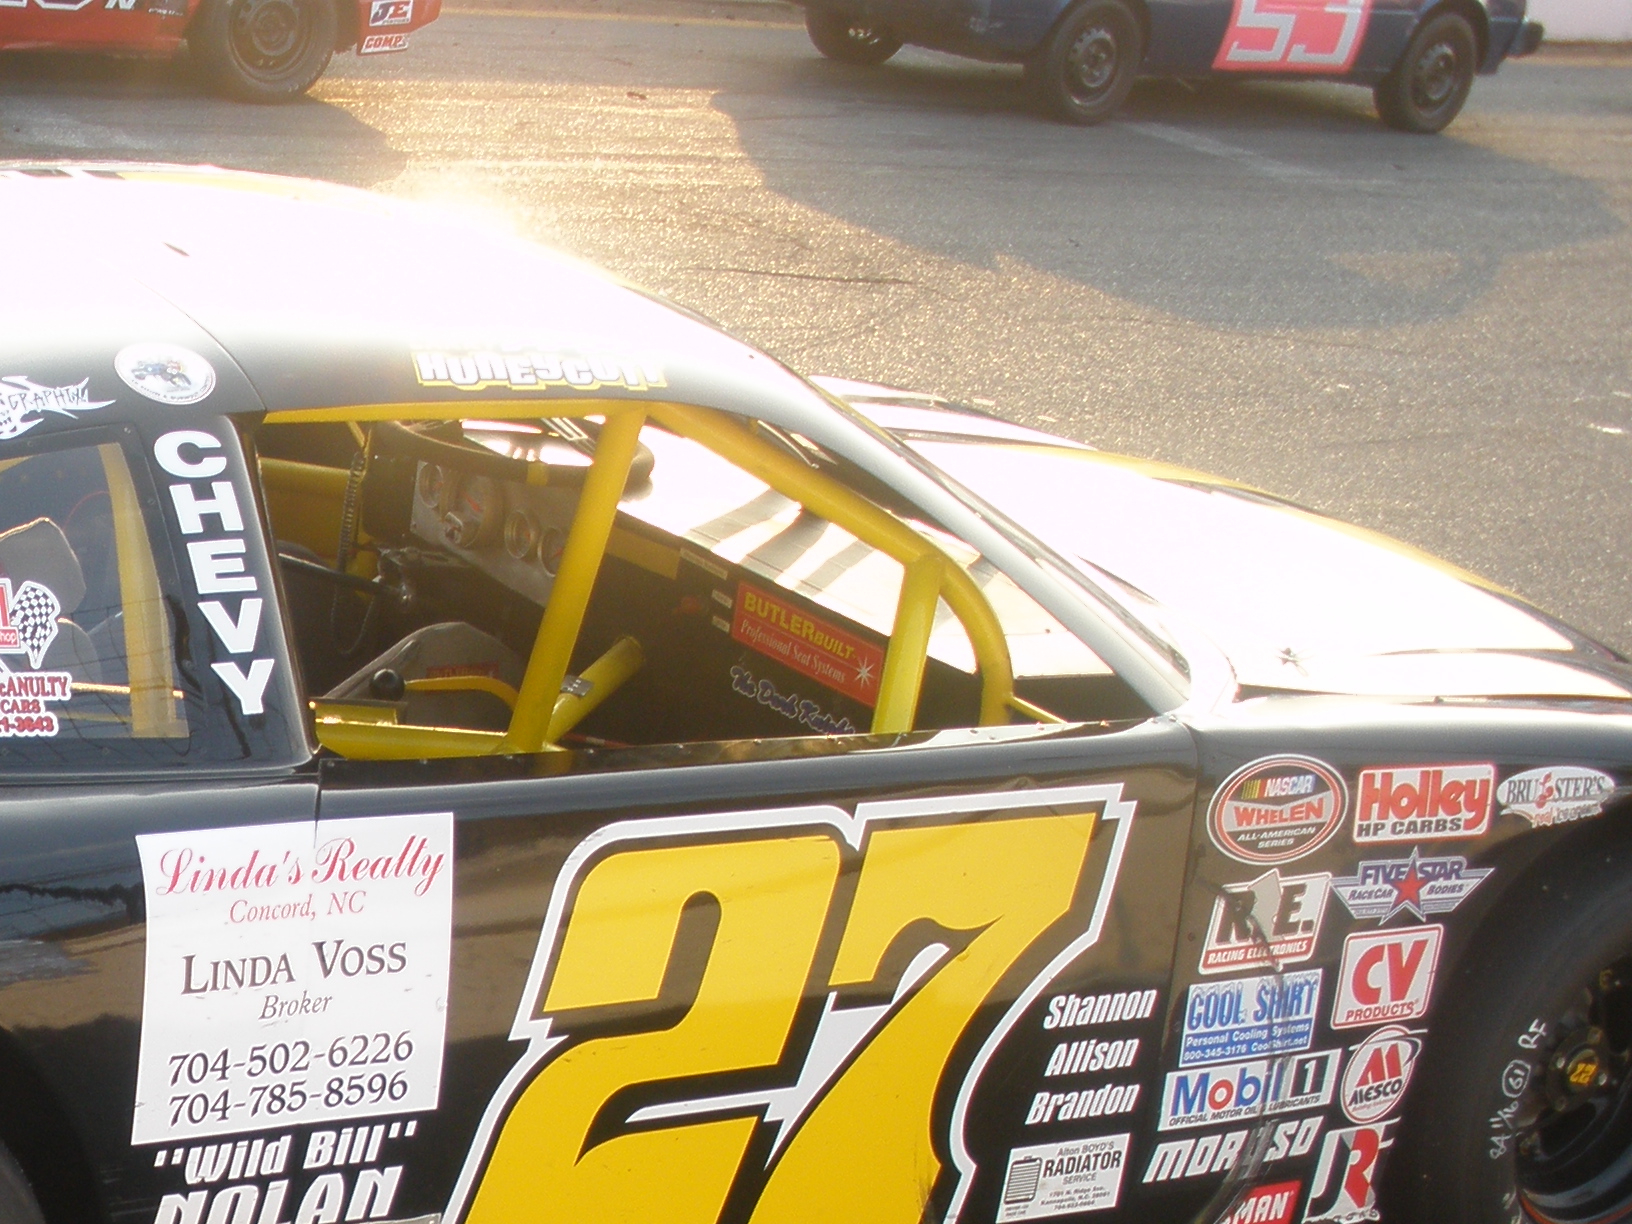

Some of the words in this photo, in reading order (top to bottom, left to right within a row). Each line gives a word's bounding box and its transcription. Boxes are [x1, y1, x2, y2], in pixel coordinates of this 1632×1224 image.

[154, 430, 275, 716] CHEVY
[741, 619, 792, 656] Professional
[812, 655, 846, 684] Systems
[0, 699, 41, 714] CARS
[1264, 775, 1314, 797] NASCAR
[1358, 769, 1491, 831] Holley
[1234, 797, 1324, 827] WHELEN
[1356, 822, 1386, 837] HP
[1390, 817, 1462, 836] CARBS
[1258, 838, 1295, 849] SERIES
[156, 847, 305, 896] Linda's
[311, 835, 445, 897] Realty
[1360, 862, 1410, 886] FIVE
[1417, 860, 1463, 880] STAR
[1427, 883, 1464, 896] BODIES
[229, 894, 317, 923] Concord,
[326, 890, 367, 915] NC
[181, 953, 297, 996] LINDA
[311, 939, 407, 979] VOSS
[1207, 949, 1245, 965] RACING
[1352, 939, 1429, 1006] CV
[258, 991, 333, 1021] Broker
[1043, 989, 1157, 1030] Shannon
[1188, 982, 1246, 1031] COOL
[1345, 1001, 1415, 1022] PRODUCTS
[1186, 1032, 1228, 1048] Personal
[1232, 1028, 1268, 1042] Cooling
[1272, 1022, 1310, 1037] Systems
[168, 1030, 414, 1087] 704-502-6226
[1044, 1038, 1140, 1077] Allison
[168, 1070, 408, 1127] 704-785-8596
[1170, 1060, 1284, 1117] Mobil
[1304, 1059, 1318, 1094] 1
[1025, 1083, 1141, 1125] Brandon
[1169, 1113, 1208, 1126] OFFICIAL
[1210, 1108, 1243, 1121] MOTOR
[1244, 1105, 1258, 1115] OIL
[1268, 1095, 1321, 1111] LUBRICANTS
[1043, 1150, 1122, 1178] RADIATOR
[1057, 1147, 1079, 1157] Alton
[1081, 1141, 1115, 1154] BOYD'S
[1062, 1173, 1097, 1185] SERVICE
